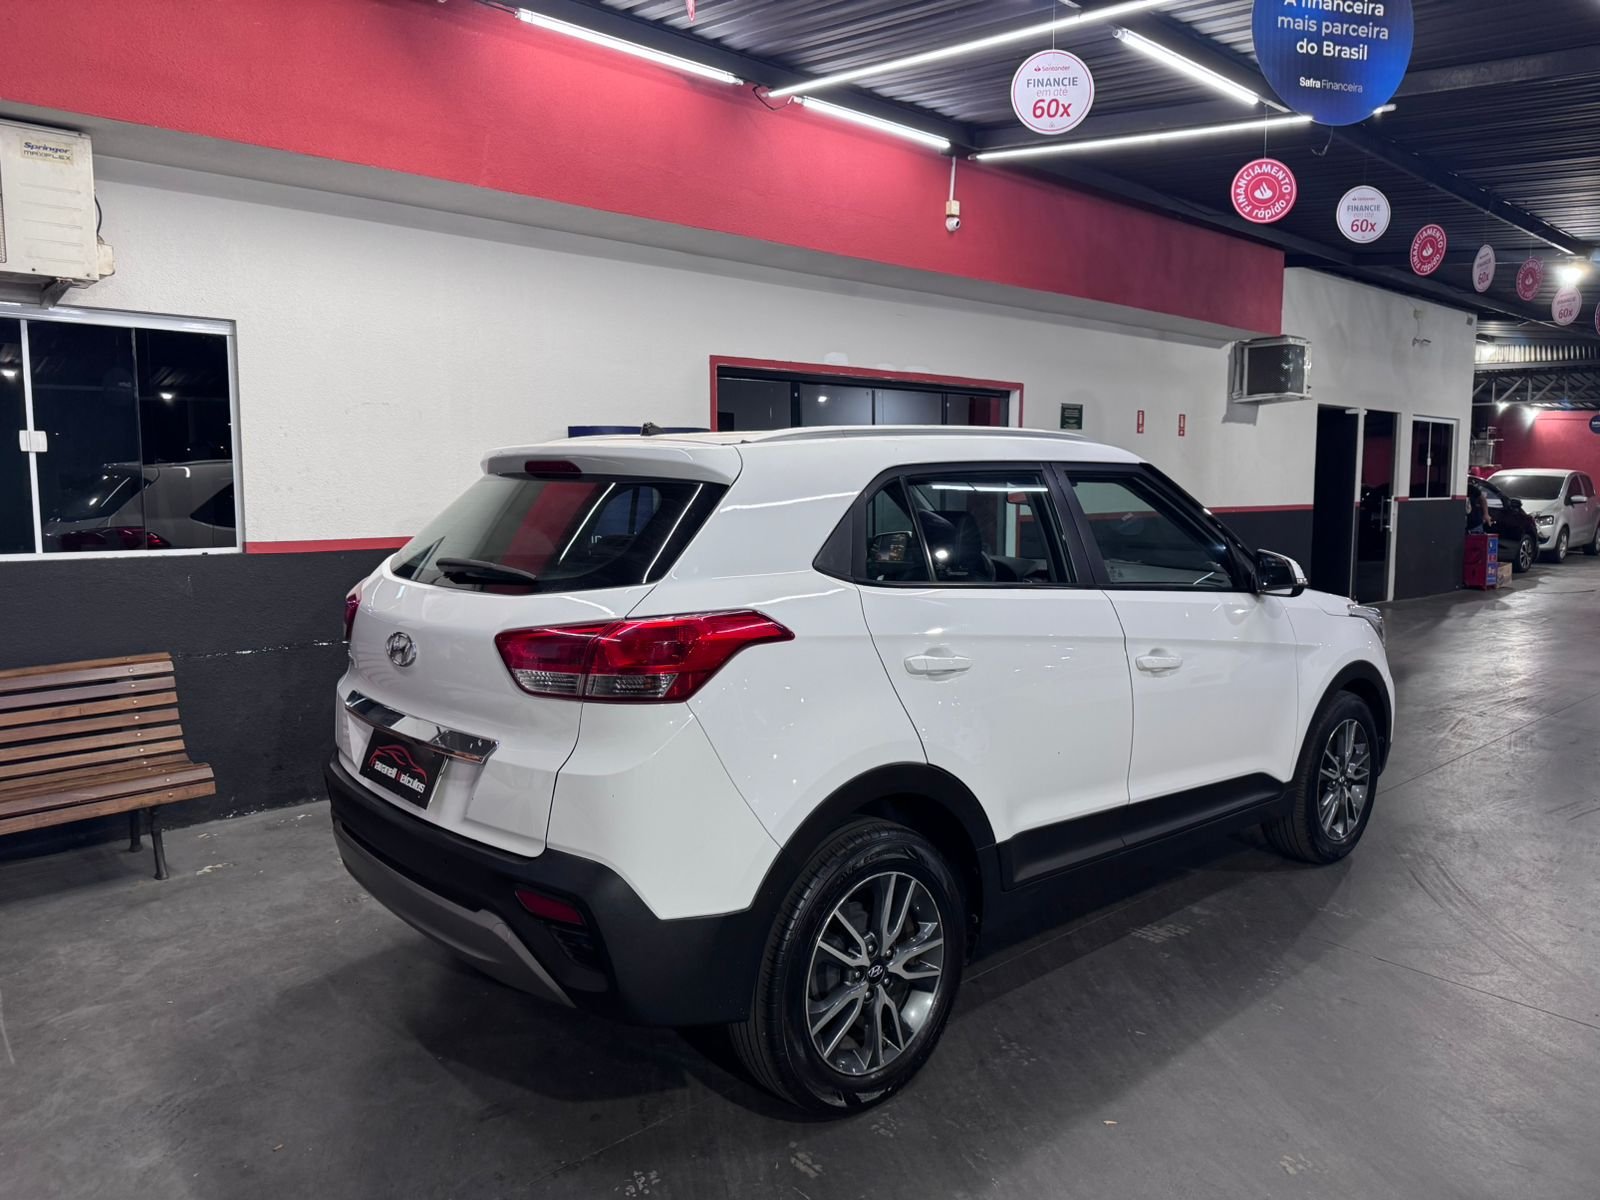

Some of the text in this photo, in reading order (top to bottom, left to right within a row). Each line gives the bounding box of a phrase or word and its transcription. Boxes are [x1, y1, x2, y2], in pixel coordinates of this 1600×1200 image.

[1277, 15, 1389, 40] mais parceira
[1296, 38, 1368, 61] do Brasil
[1026, 76, 1079, 89] FINANCIE
[1299, 76, 1363, 93] Safra Financeira
[1036, 87, 1069, 97] em até
[1032, 98, 1073, 119] 60x
[24, 141, 70, 153] Springer
[1235, 163, 1292, 213] FINANCIAMENTO
[1252, 199, 1287, 221] rápido
[1347, 204, 1381, 212] FINANCIE
[1350, 218, 1377, 233] 60x
[1412, 227, 1444, 271] FINANCIAMENTO
[1558, 307, 1574, 320] 60x
